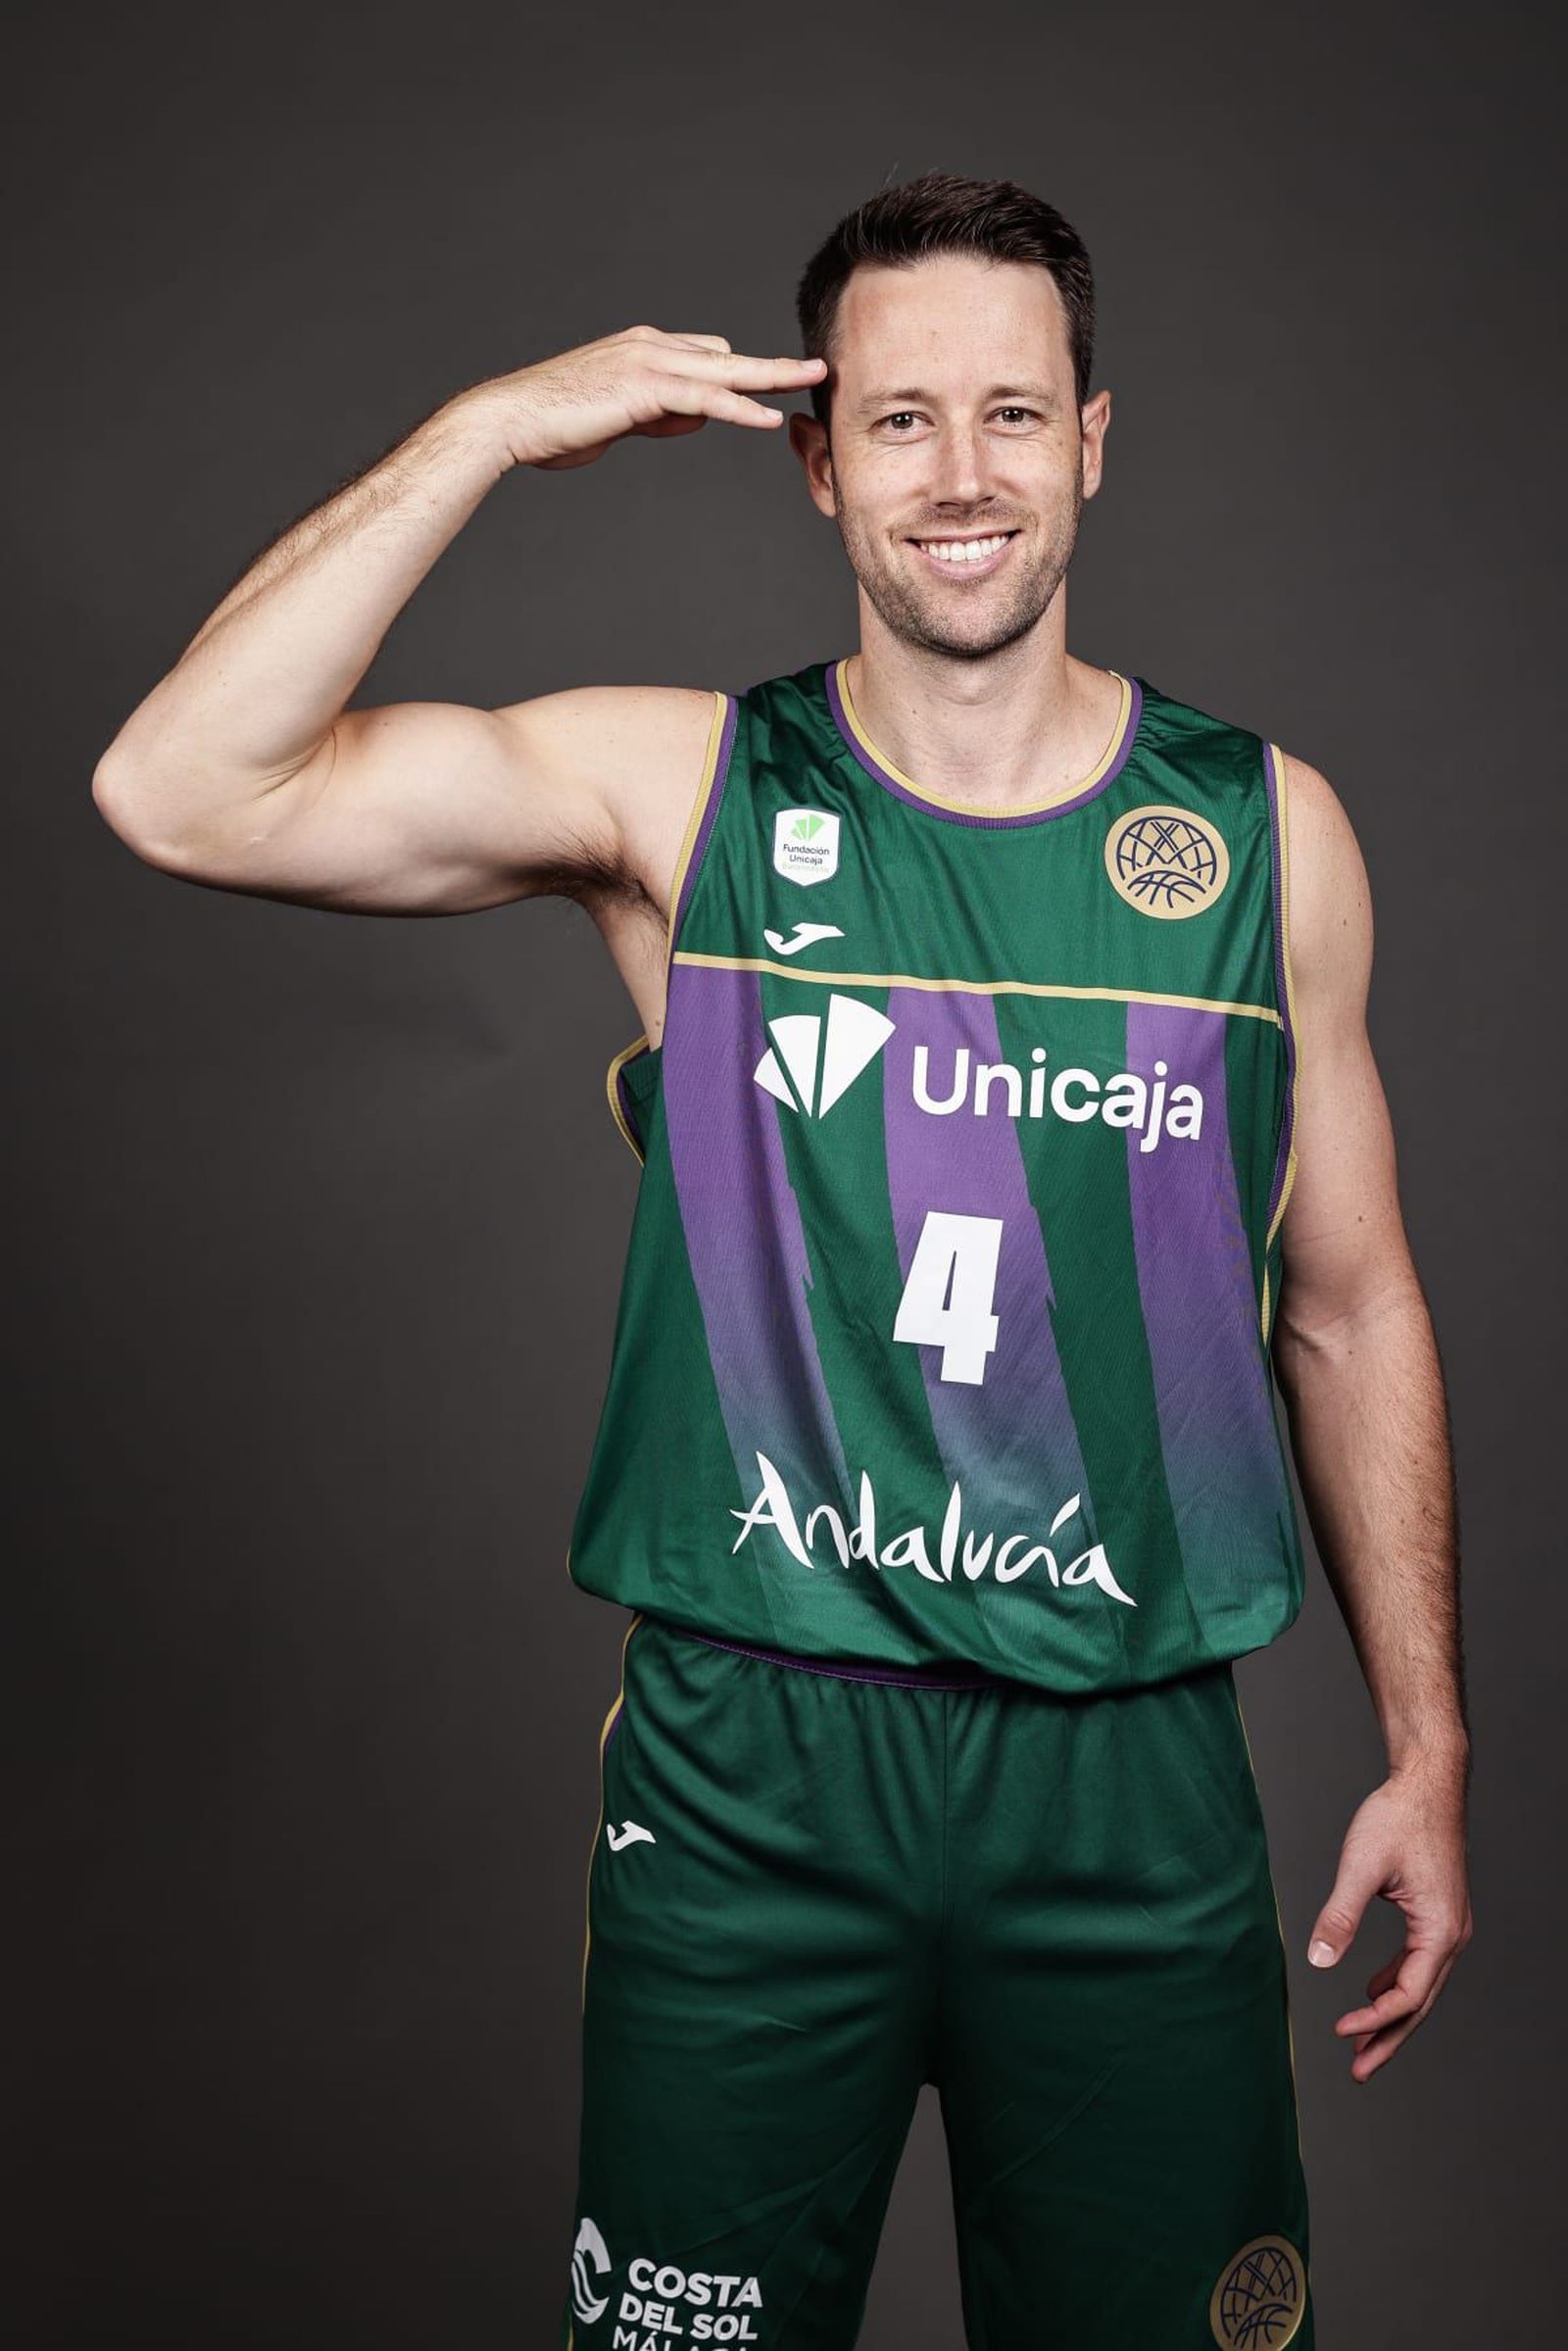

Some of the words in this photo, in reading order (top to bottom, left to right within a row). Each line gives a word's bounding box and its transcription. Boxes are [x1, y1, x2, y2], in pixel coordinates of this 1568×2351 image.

[783, 844, 830, 856] Fundación
[789, 855, 823, 866] Unicaja
[912, 1046, 1203, 1153] Unicaja
[893, 1211, 1004, 1386] 4
[729, 1450, 1138, 1607] Andalucía
[628, 2258, 763, 2308] COSTA
[618, 2292, 683, 2335] DEL
[690, 2314, 759, 2341] SOL
